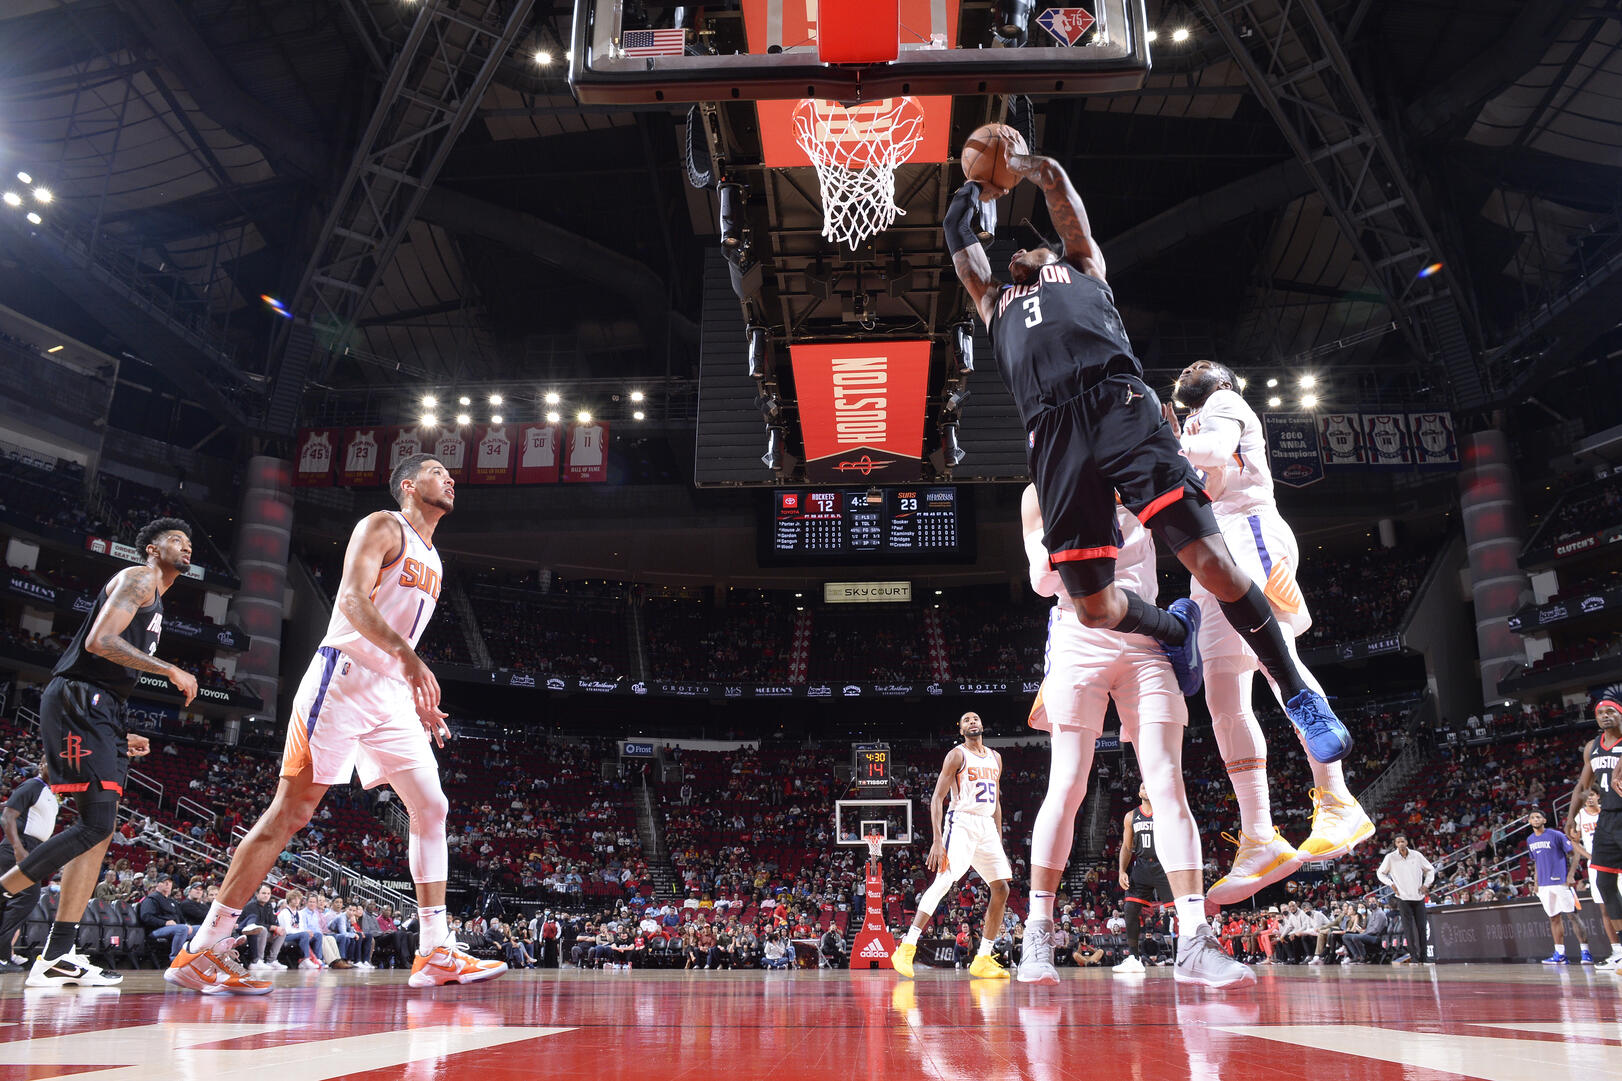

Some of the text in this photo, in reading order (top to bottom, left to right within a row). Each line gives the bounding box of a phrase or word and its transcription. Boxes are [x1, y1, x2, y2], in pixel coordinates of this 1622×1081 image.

[1071, 14, 1082, 26] 75
[1023, 296, 1043, 328] 3
[832, 357, 887, 443] HOUSTON
[585, 437, 591, 447] 11
[310, 449, 323, 459] 45
[356, 448, 368, 458] 23
[400, 446, 413, 456] 24
[443, 445, 456, 455] 22
[487, 445, 501, 455] 34
[1272, 450, 1317, 459] Champions
[818, 501, 833, 511] 12
[851, 497, 868, 506] 4:3
[901, 499, 917, 510] 23
[1557, 537, 1595, 554] CLUTCH'S
[409, 598, 424, 639] 1
[140, 677, 168, 688] OYOTA
[200, 688, 230, 700] TOYOTA
[127, 708, 168, 730] rost
[866, 753, 886, 762] 4:30
[869, 763, 884, 776] 14
[968, 767, 999, 781] SUNS
[1601, 773, 1609, 792] 4
[976, 782, 995, 803] 25
[1133, 821, 1153, 833] HOUST
[1583, 822, 1597, 832] SU
[1141, 834, 1150, 848] 10
[1529, 841, 1551, 852] PHOENIX
[382, 880, 413, 890] TUNNEL
[1517, 921, 1550, 938] PARTNE
[934, 947, 954, 961] LIG
